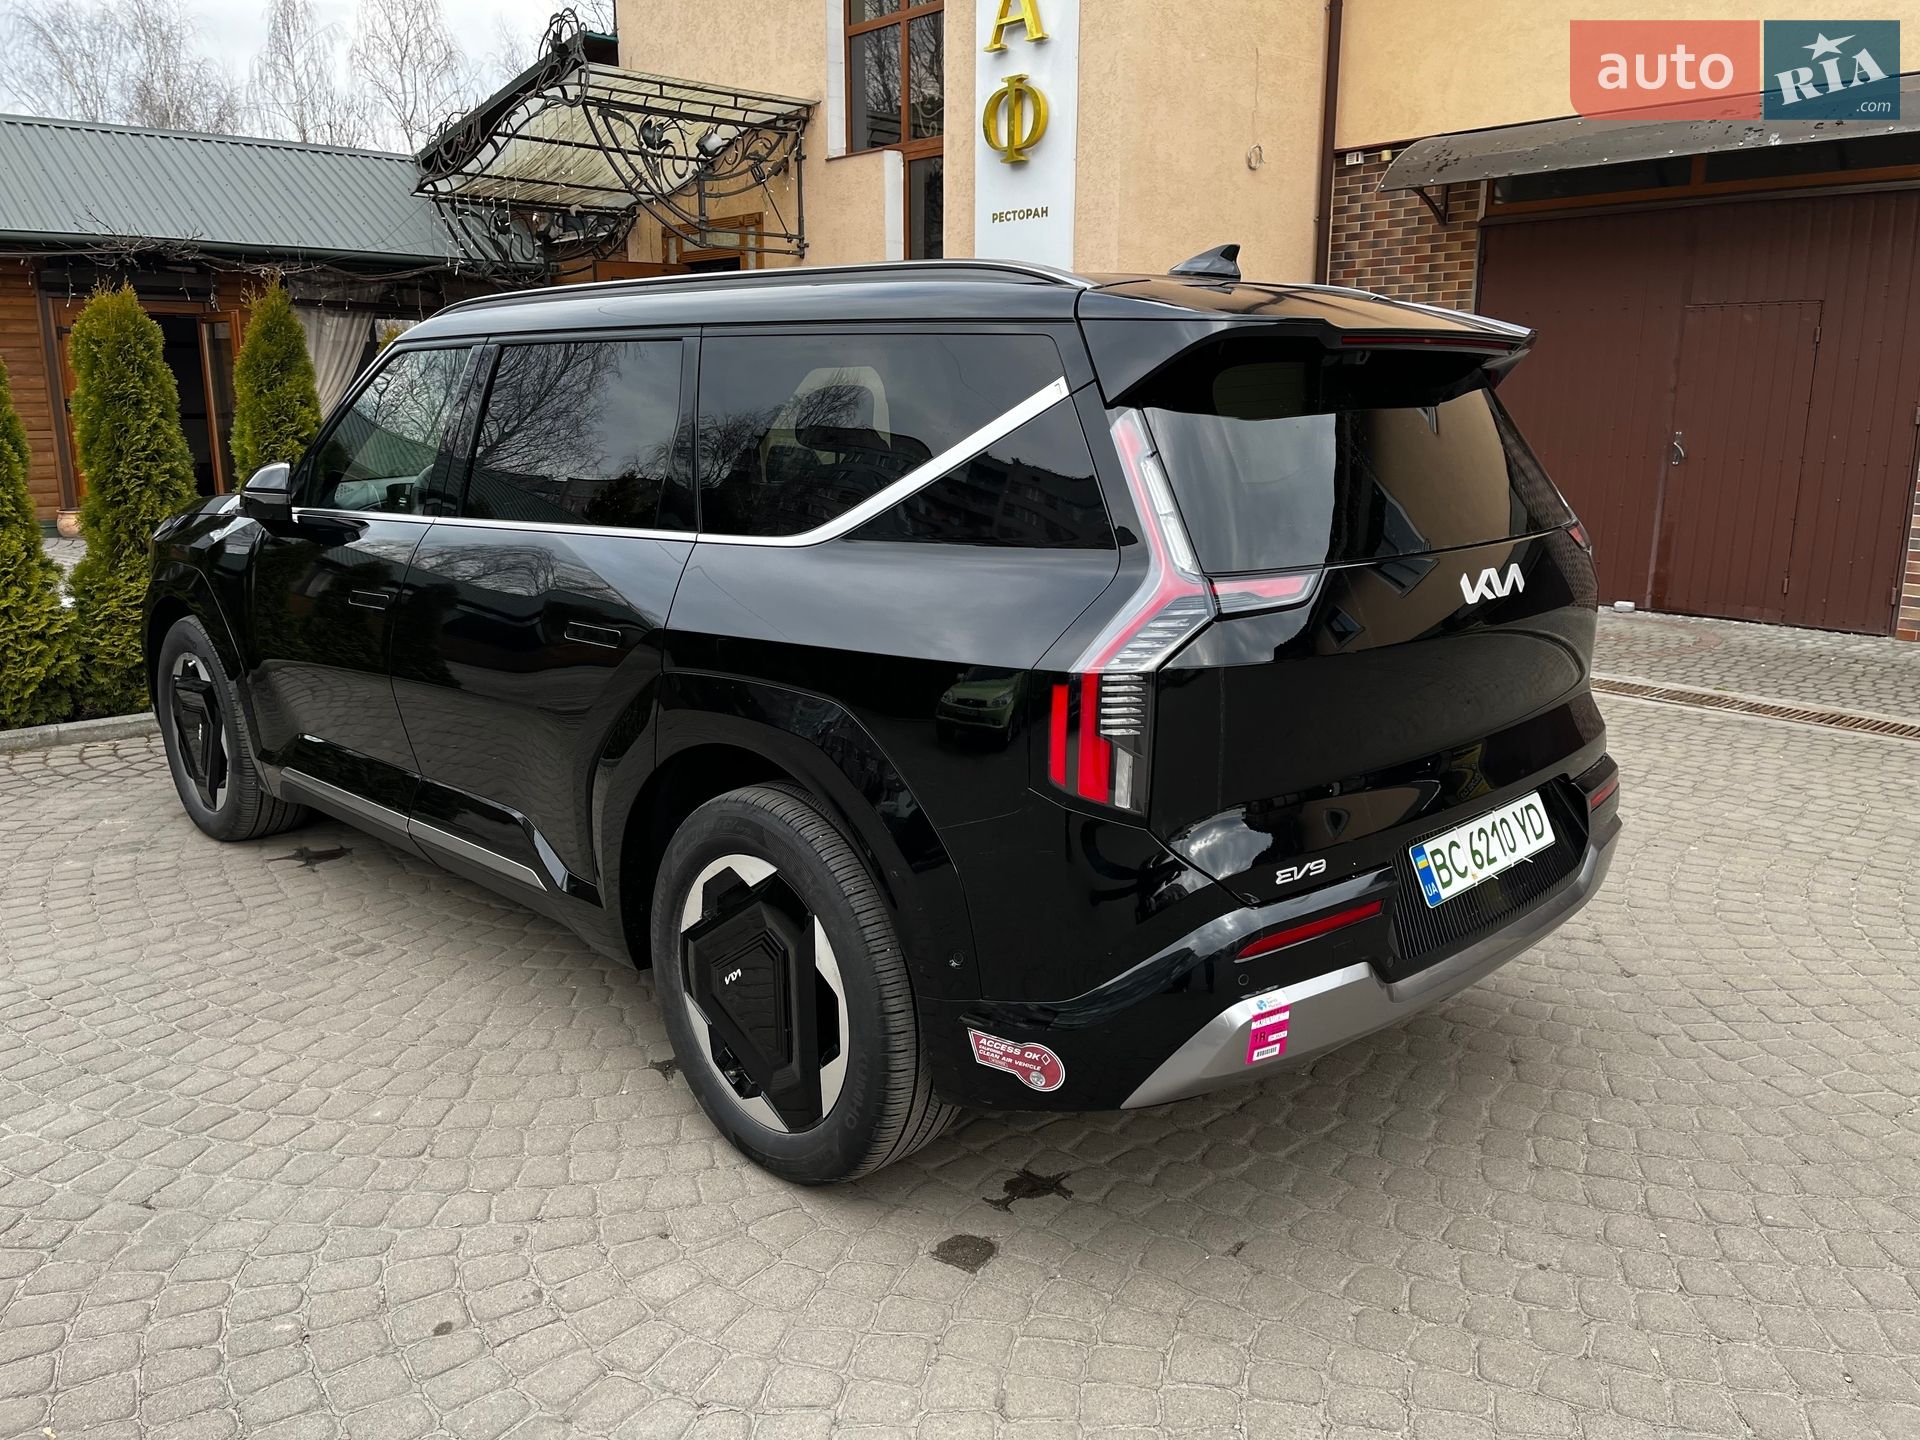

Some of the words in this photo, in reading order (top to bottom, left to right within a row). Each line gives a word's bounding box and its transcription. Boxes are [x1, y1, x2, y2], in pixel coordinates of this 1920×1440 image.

[991, 206, 1049, 224] РЕСТОРАН
[1460, 563, 1525, 605] KIA
[1429, 840, 1469, 890] BC
[1469, 817, 1517, 870] 6210
[1512, 803, 1545, 845] YD
[1276, 858, 1326, 885] EV9
[1425, 882, 1439, 897] UA
[978, 1049, 1000, 1060] CLEAN
[1014, 1060, 1042, 1071] VEHICLE
[979, 1038, 1022, 1056] ACCESS
[1024, 1051, 1042, 1061] OK
